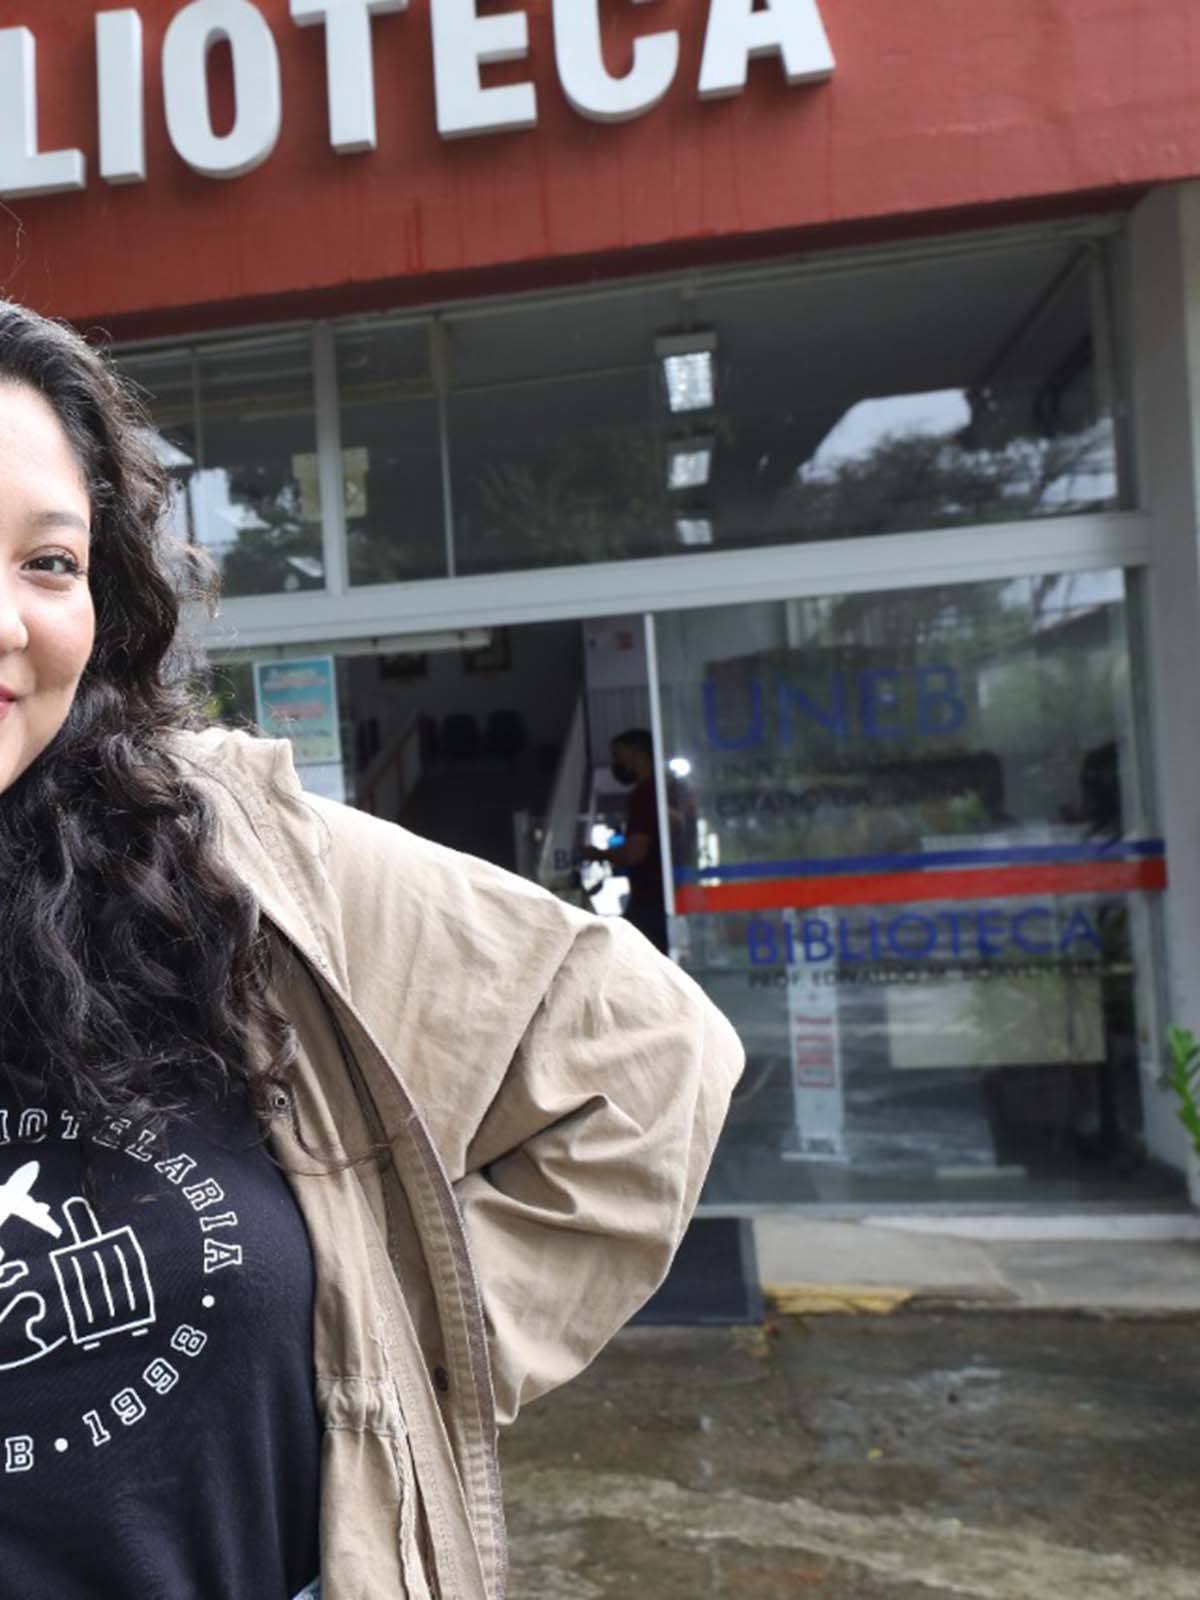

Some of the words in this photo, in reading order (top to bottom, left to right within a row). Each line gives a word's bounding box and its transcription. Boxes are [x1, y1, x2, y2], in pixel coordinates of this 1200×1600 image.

[702, 663, 968, 749] UNEB
[747, 906, 1102, 967] BIBLIOTECA
[82, 1324, 208, 1447] 1998
